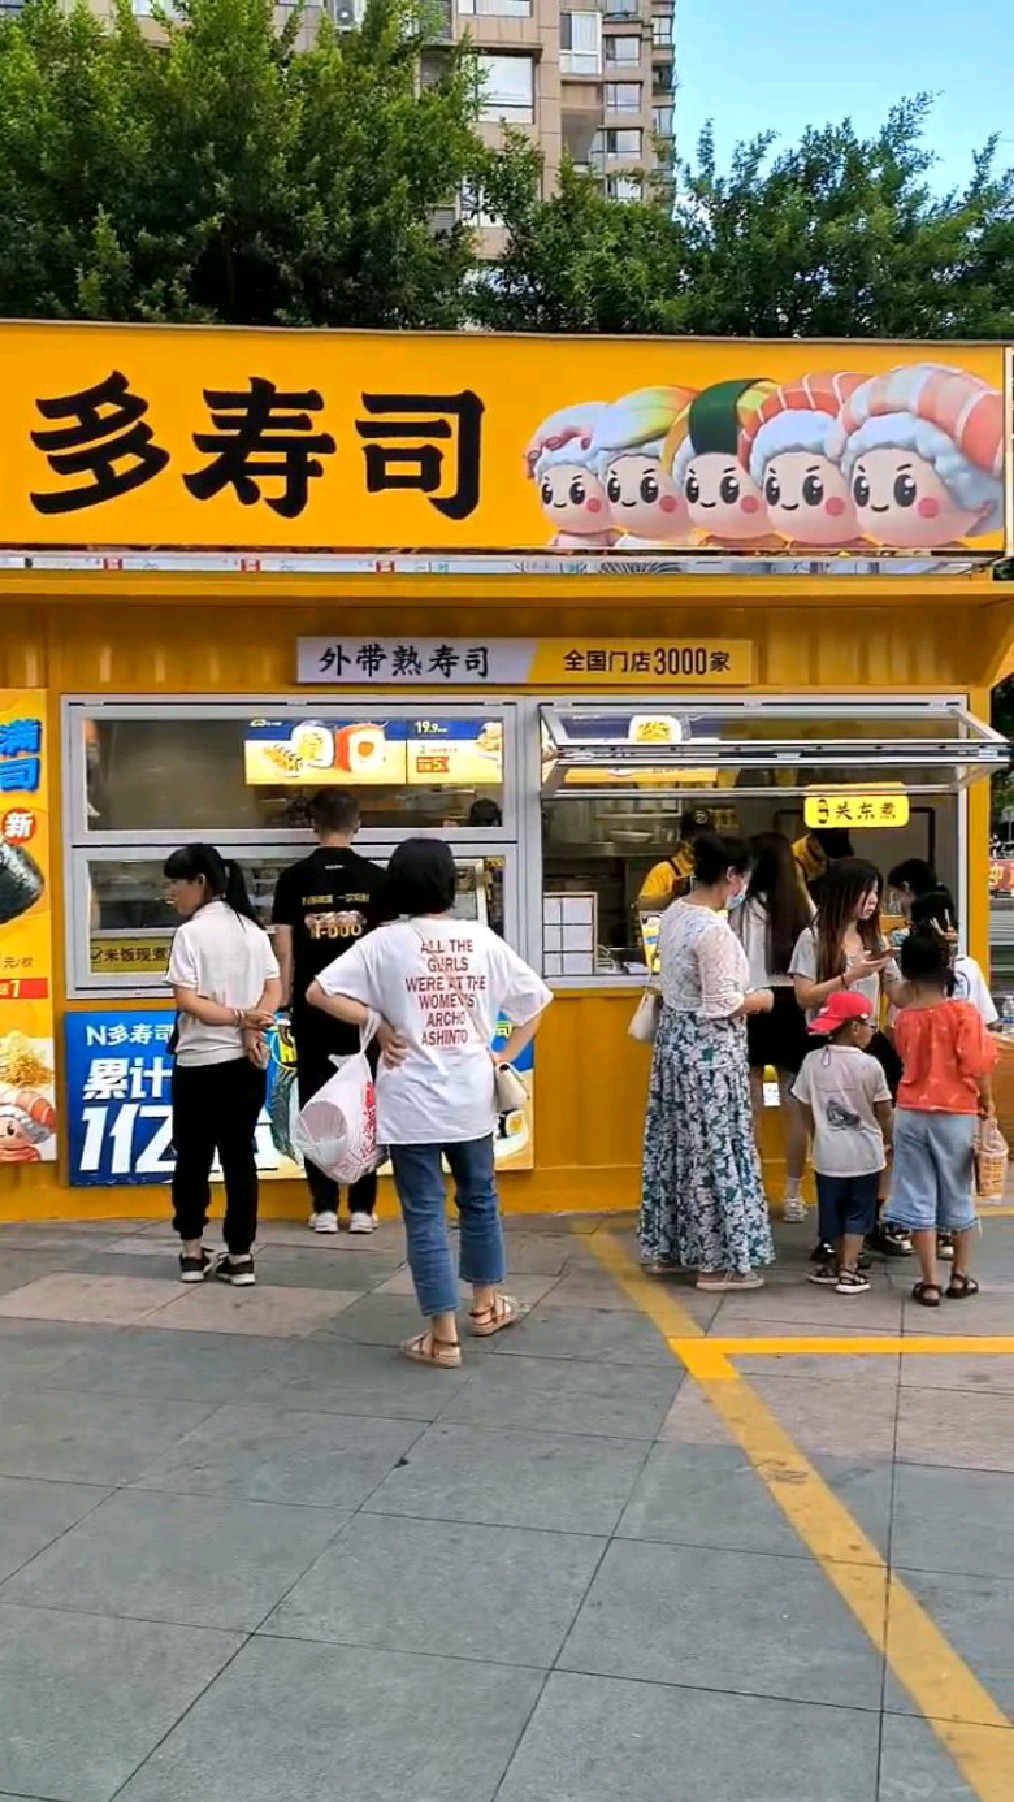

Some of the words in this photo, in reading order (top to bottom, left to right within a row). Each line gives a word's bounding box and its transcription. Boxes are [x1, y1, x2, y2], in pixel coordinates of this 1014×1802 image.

[30, 370, 485, 520] 多寿司
[319, 644, 489, 679] 外带熟寿司
[563, 647, 731, 676] 全国门店3000家
[449, 939, 473, 953] THE
[405, 976, 445, 992] WERE
[82, 1056, 173, 1100] 累计
